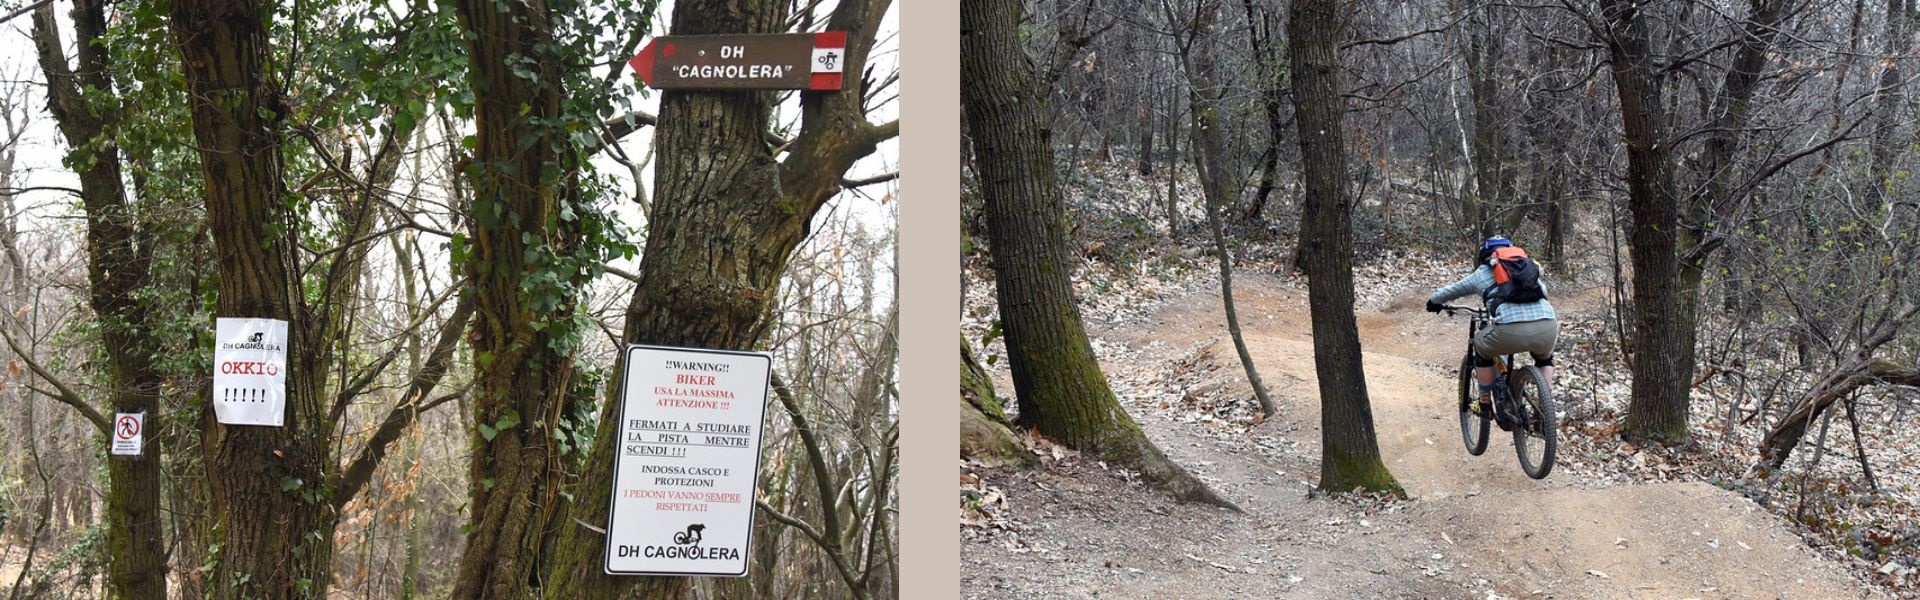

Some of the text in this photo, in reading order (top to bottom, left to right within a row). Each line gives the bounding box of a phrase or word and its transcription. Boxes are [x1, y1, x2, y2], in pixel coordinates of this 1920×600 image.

[720, 45, 745, 59] DH
[221, 361, 278, 376] OKKIO
[665, 360, 730, 373] !!WARNING!!
[676, 374, 716, 386] BIKER
[654, 386, 735, 400] USA LA MASSIMA
[656, 399, 718, 410] ATTENZIONE
[629, 419, 751, 434] FERMATI A STUDIARE
[628, 432, 750, 447] LA PISTA MENTRE
[626, 445, 667, 456] SCENDI
[641, 465, 730, 477] INDOSSA CASCO E
[654, 477, 714, 488] PROTEZIONI
[629, 489, 666, 499] PEDONI
[668, 491, 705, 501] VANNO
[705, 492, 742, 502] SEMPRE
[656, 502, 709, 512] RISPETTATI
[618, 545, 740, 560] DH CAGNOLERA
